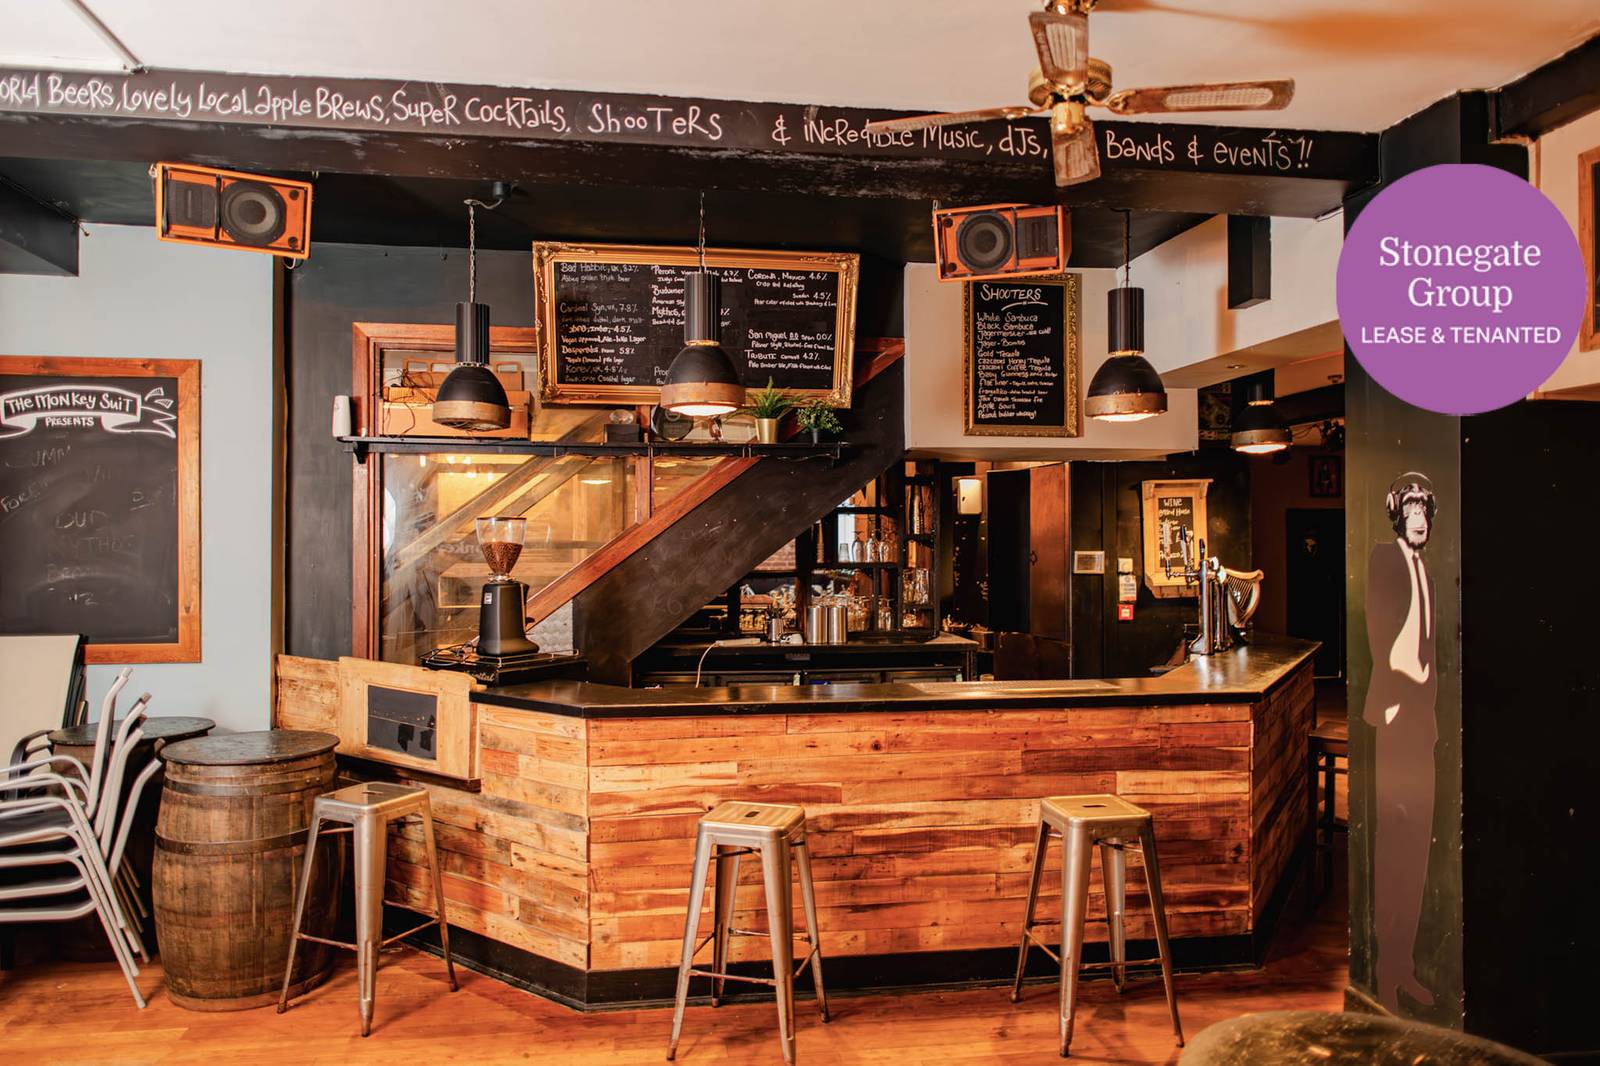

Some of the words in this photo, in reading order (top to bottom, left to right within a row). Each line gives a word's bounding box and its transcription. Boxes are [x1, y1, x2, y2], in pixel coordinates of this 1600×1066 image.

[771, 114, 791, 147] &
[1188, 135, 1204, 165] &
[980, 284, 1042, 302] SHOOTERS
[45, 416, 95, 428] PRESENTS
